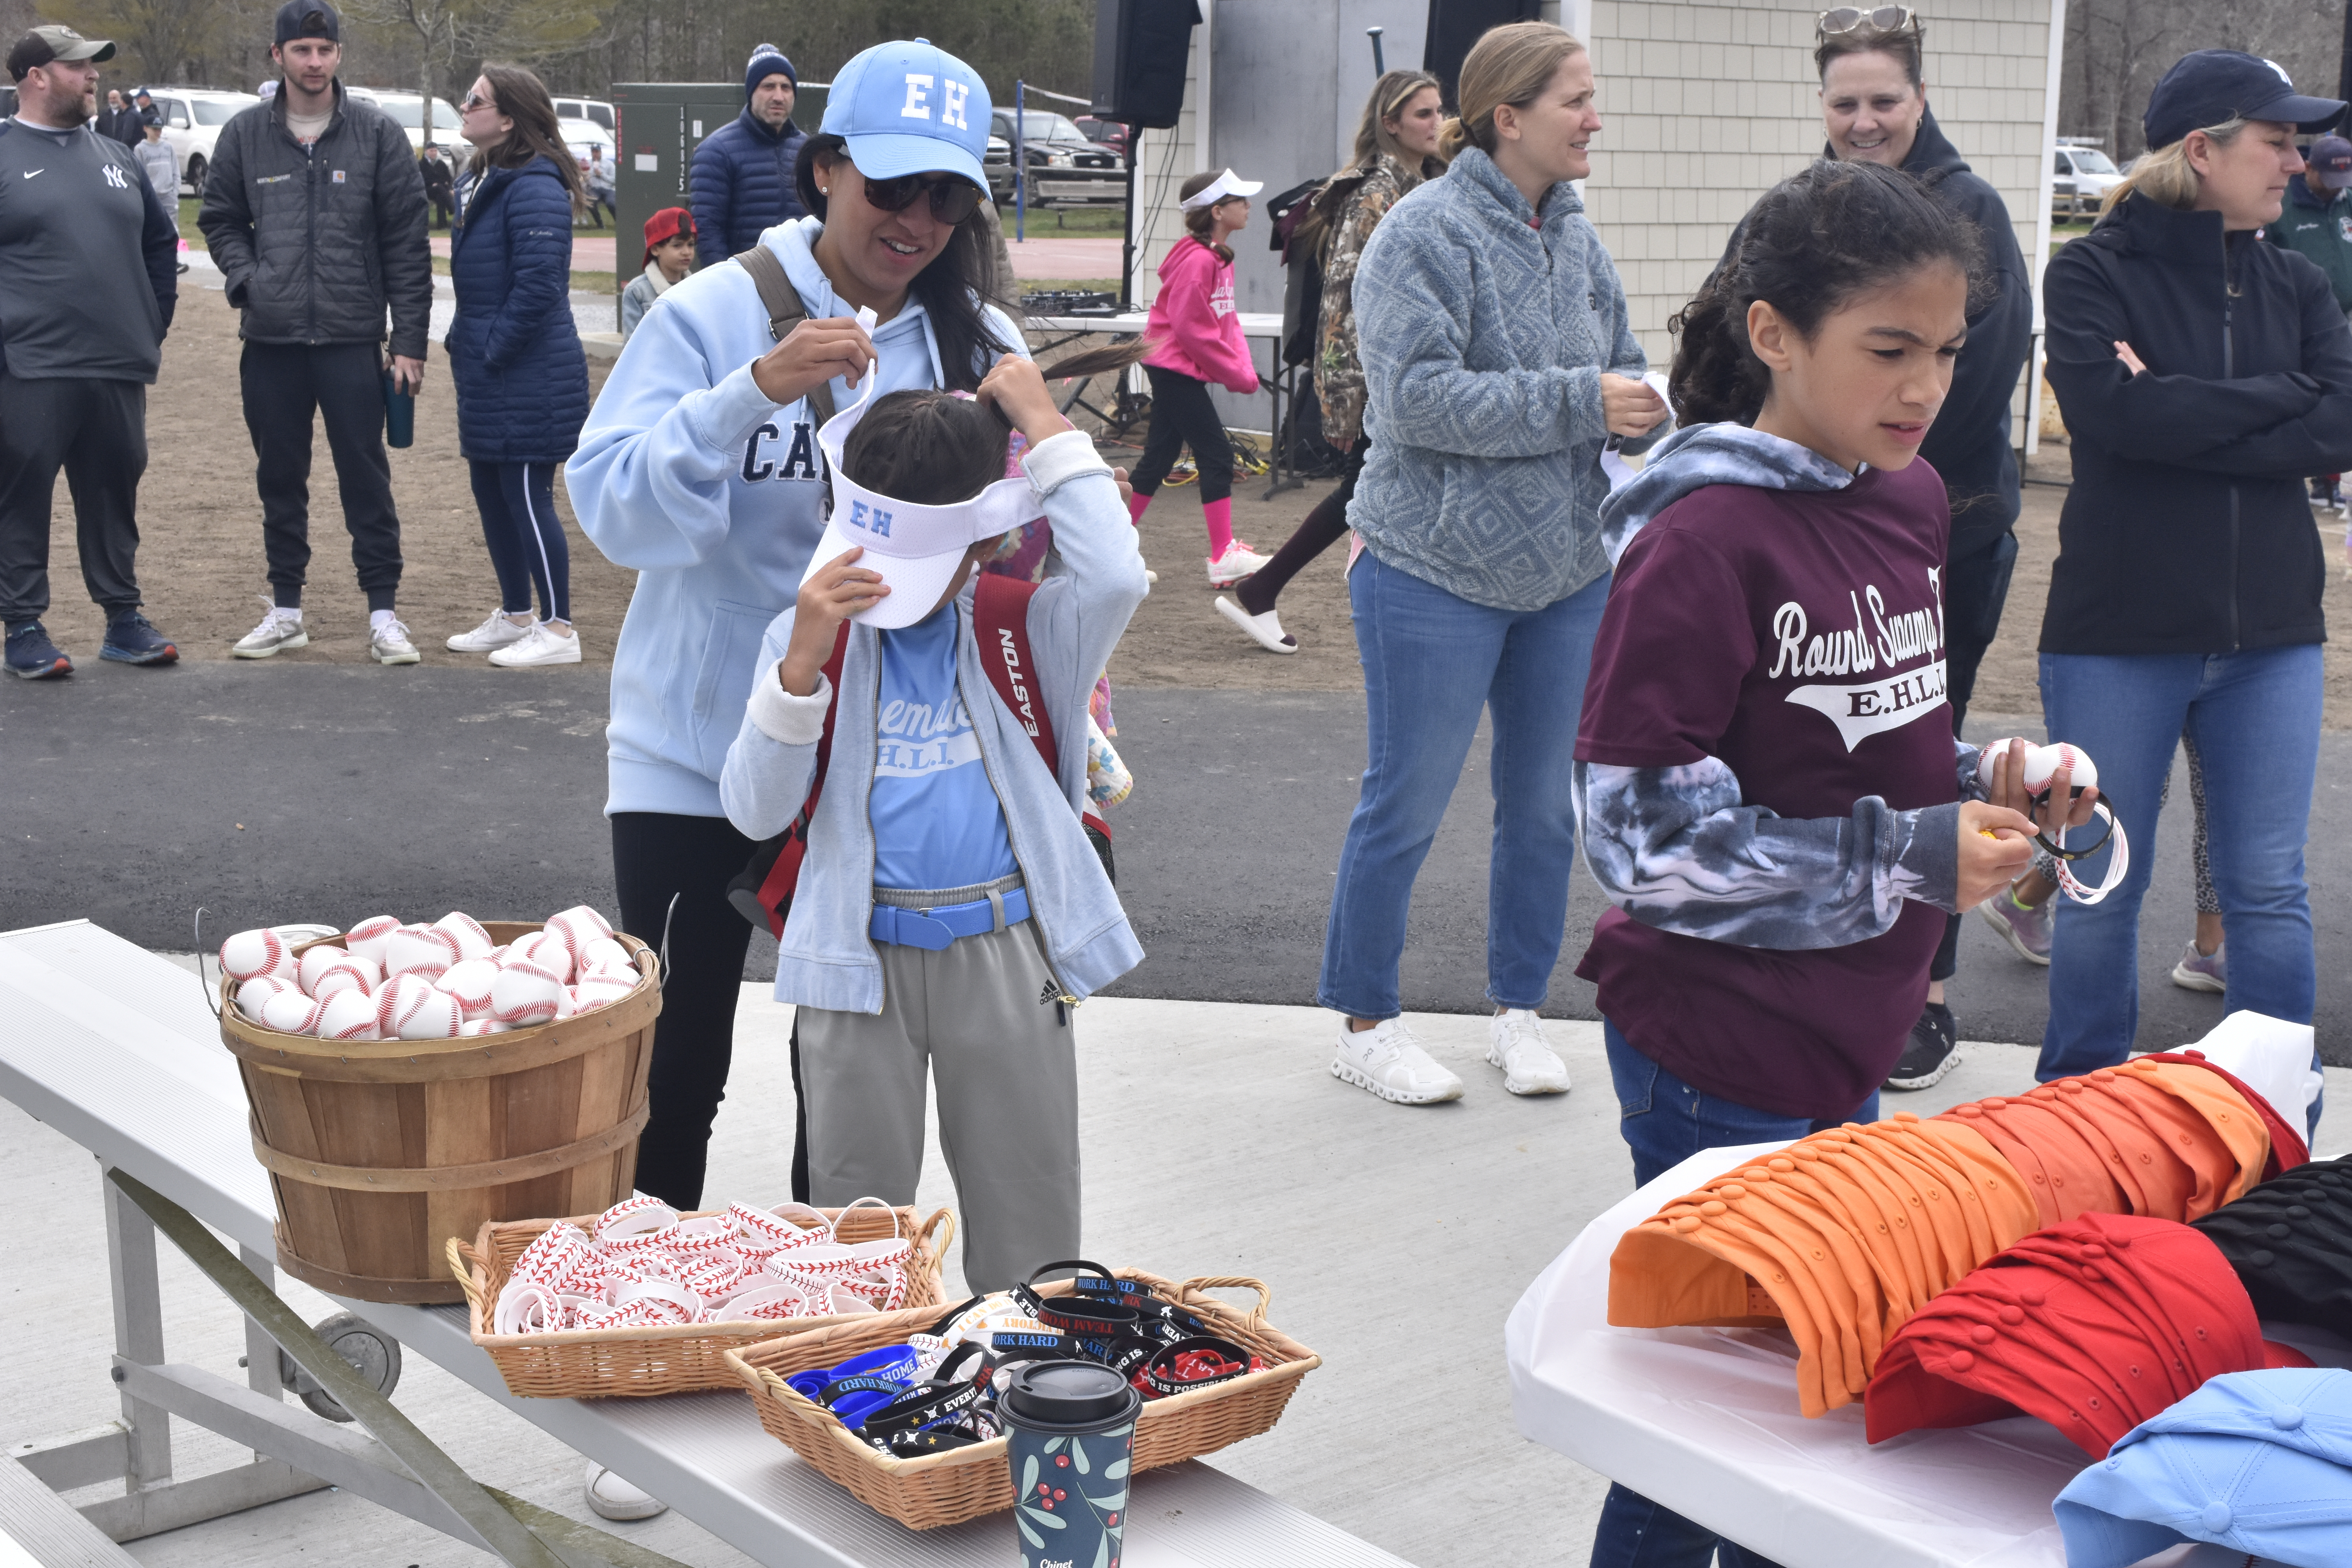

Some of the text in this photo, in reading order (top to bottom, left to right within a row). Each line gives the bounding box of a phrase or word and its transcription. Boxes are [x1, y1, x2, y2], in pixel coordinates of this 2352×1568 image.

[901, 73, 969, 131] EH
[849, 499, 893, 538] EH
[1769, 591, 1875, 679] Round
[1866, 584, 1937, 668] Swamp
[998, 628, 1039, 737] EASTON
[1040, 989, 1061, 1005] adidas
[1078, 1278, 1135, 1292] WORK HRD
[965, 1306, 987, 1324] CAN
[987, 1301, 1003, 1310] DO
[1002, 1318, 1052, 1332] VICTORY
[1074, 1316, 1114, 1334] TEAM
[1018, 1335, 1058, 1347] HARD
[1129, 1348, 1143, 1360] IS
[882, 1360, 916, 1383] HOME
[838, 1378, 878, 1392] HARD
[878, 1378, 904, 1393] WORK
[1158, 1382, 1171, 1393] IS
[1040, 1558, 1073, 1568] Chinet
